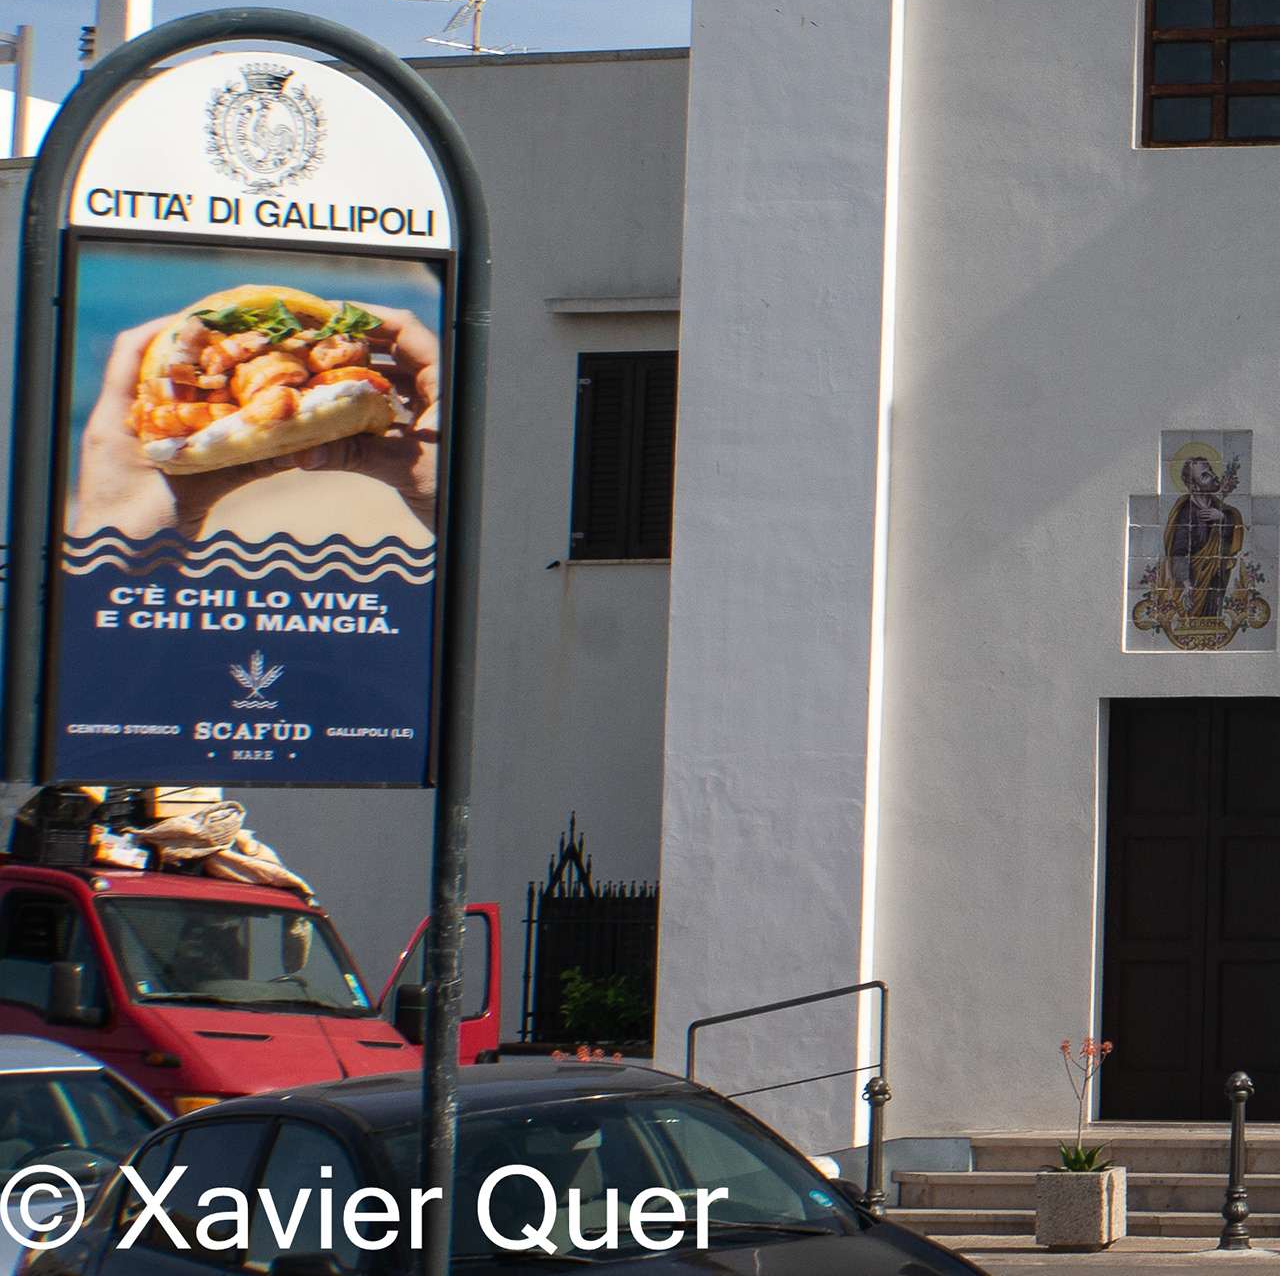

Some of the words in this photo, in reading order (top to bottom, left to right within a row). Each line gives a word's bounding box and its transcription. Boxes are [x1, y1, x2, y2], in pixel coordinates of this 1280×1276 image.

[87, 188, 194, 221] CITTA'
[209, 196, 241, 225] DI
[255, 199, 435, 236] GALLIPOLI
[175, 588, 237, 607] CHI
[246, 590, 292, 609] LO
[301, 592, 389, 615] VIVE,
[96, 610, 121, 628] E
[129, 611, 191, 629] CHI
[201, 613, 247, 631] LO
[256, 614, 400, 634] MANGIA.
[67, 724, 122, 734] CENTRO
[123, 725, 182, 735] STORICO
[326, 727, 388, 737] GALLIPOLI
[390, 728, 415, 739] (LE)
